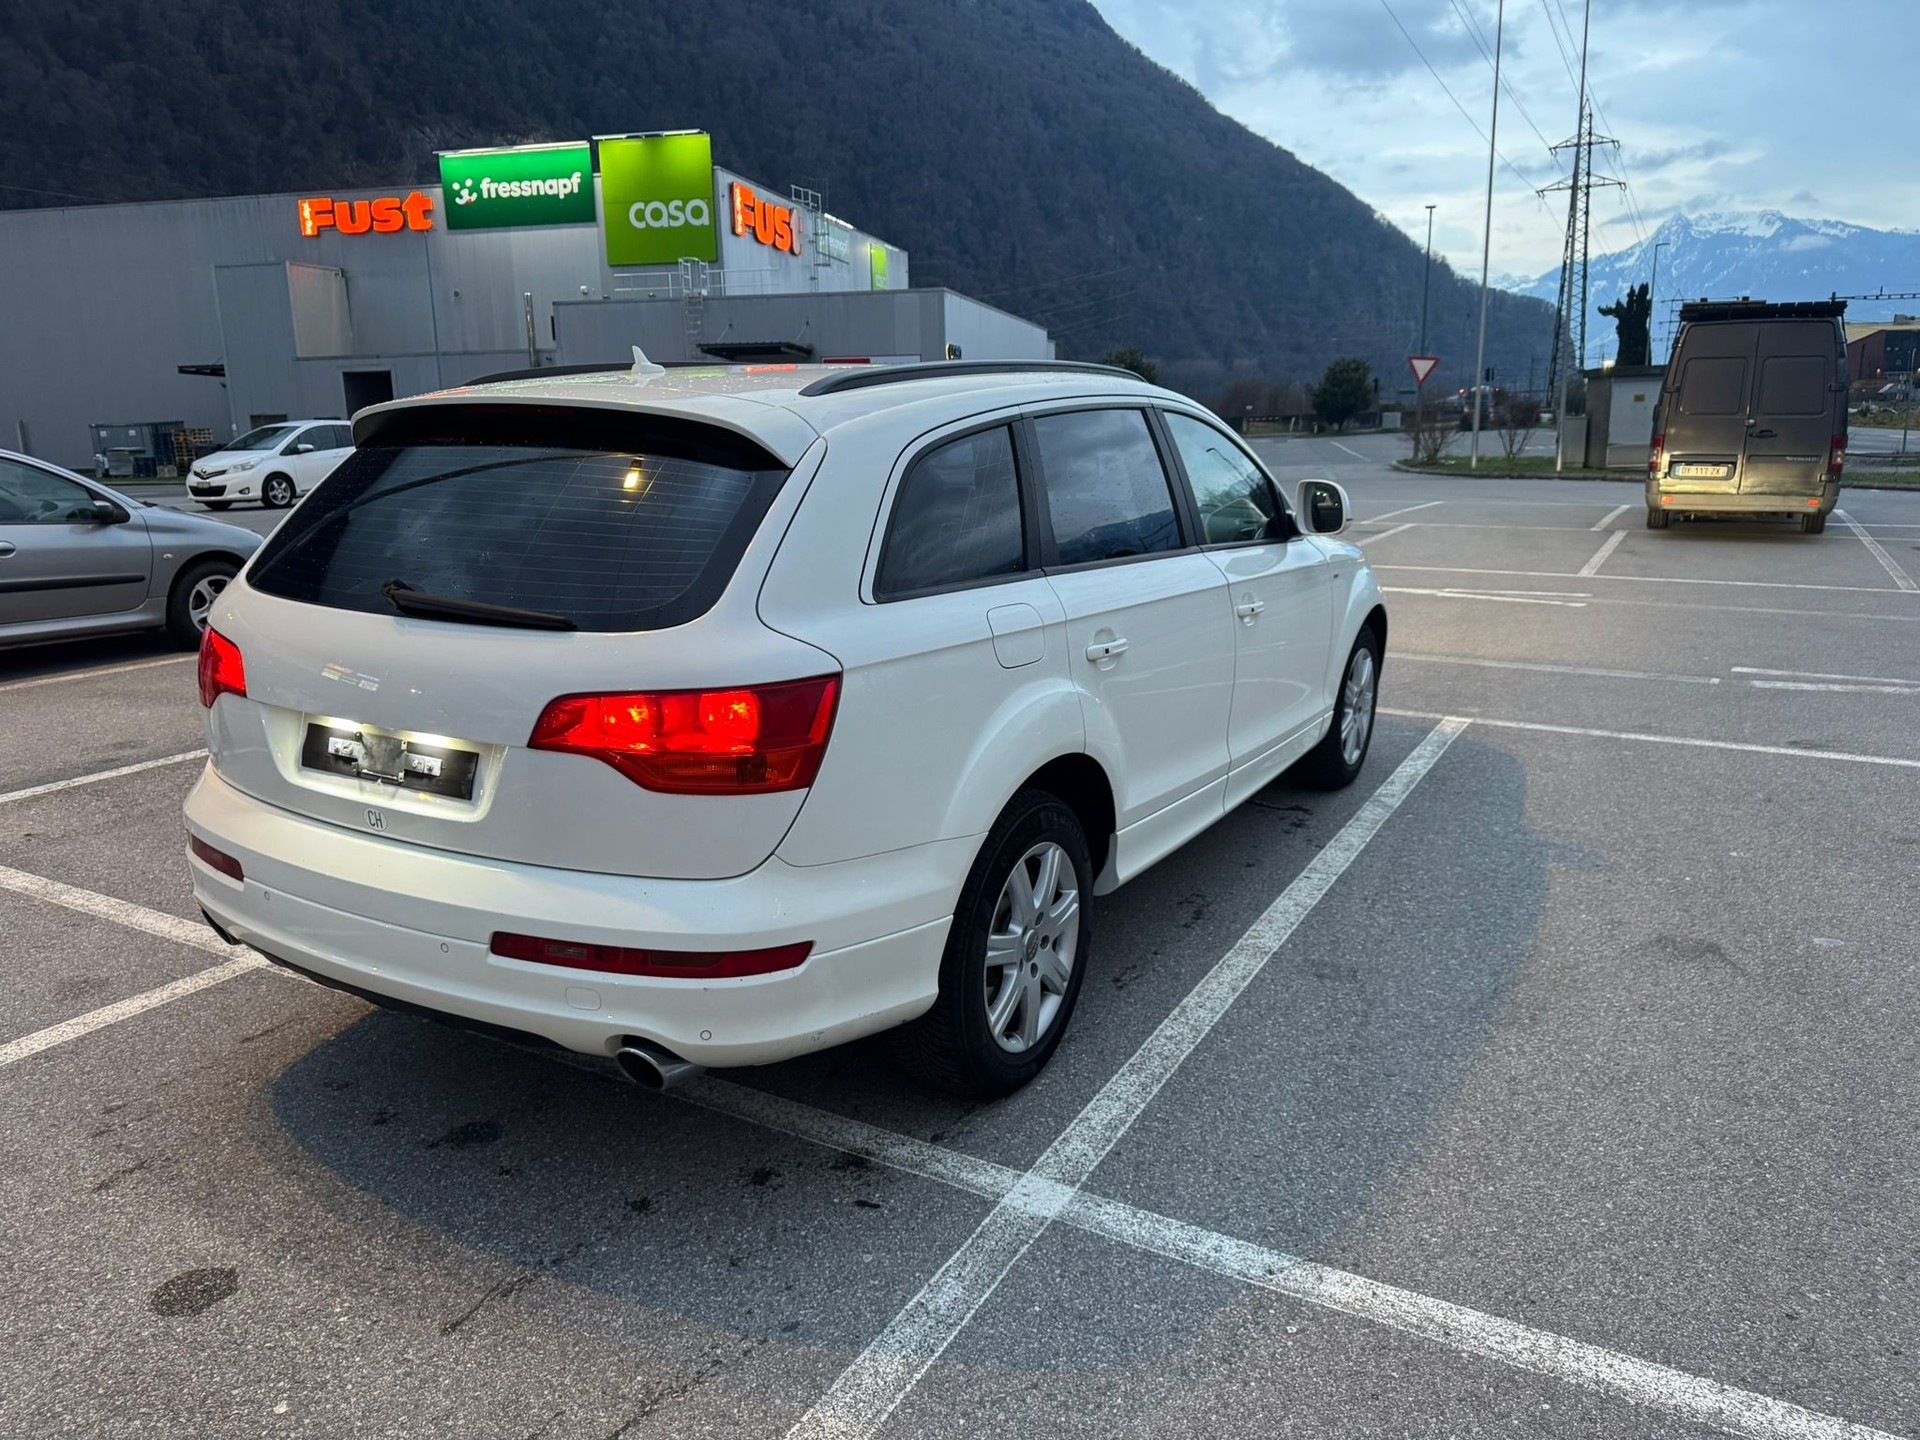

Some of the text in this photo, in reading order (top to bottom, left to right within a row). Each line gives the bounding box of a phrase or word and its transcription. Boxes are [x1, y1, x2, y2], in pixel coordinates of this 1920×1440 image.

[480, 172, 582, 199] fressnapf
[298, 191, 433, 236] Fust
[628, 199, 710, 229] casa
[367, 810, 383, 828] CH
